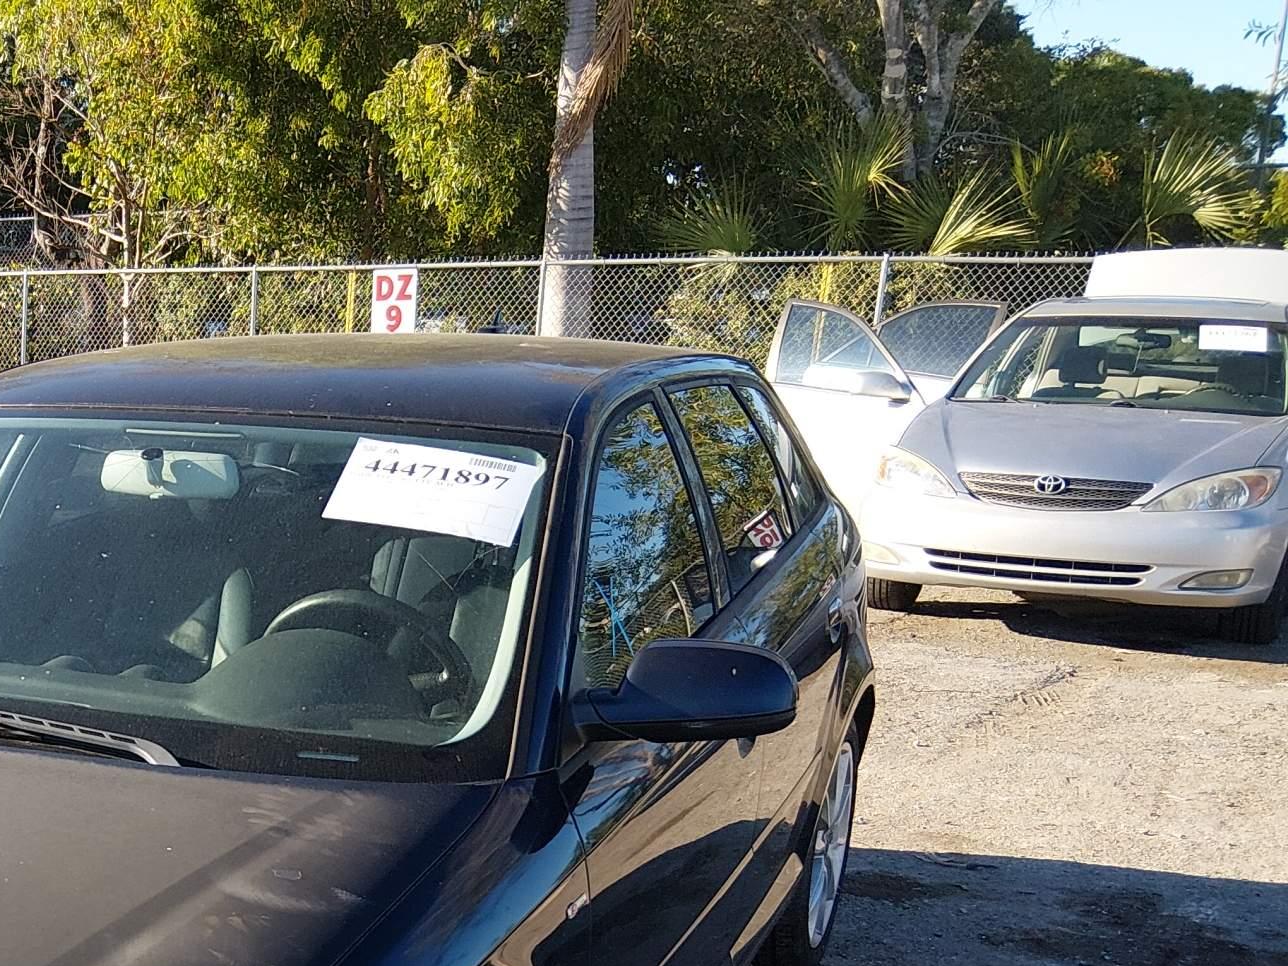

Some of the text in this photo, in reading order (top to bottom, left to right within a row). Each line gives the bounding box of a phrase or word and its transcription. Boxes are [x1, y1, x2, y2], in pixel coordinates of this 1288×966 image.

[375, 274, 413, 301] DZ
[385, 304, 402, 333] 9
[364, 459, 511, 490] 44471897
